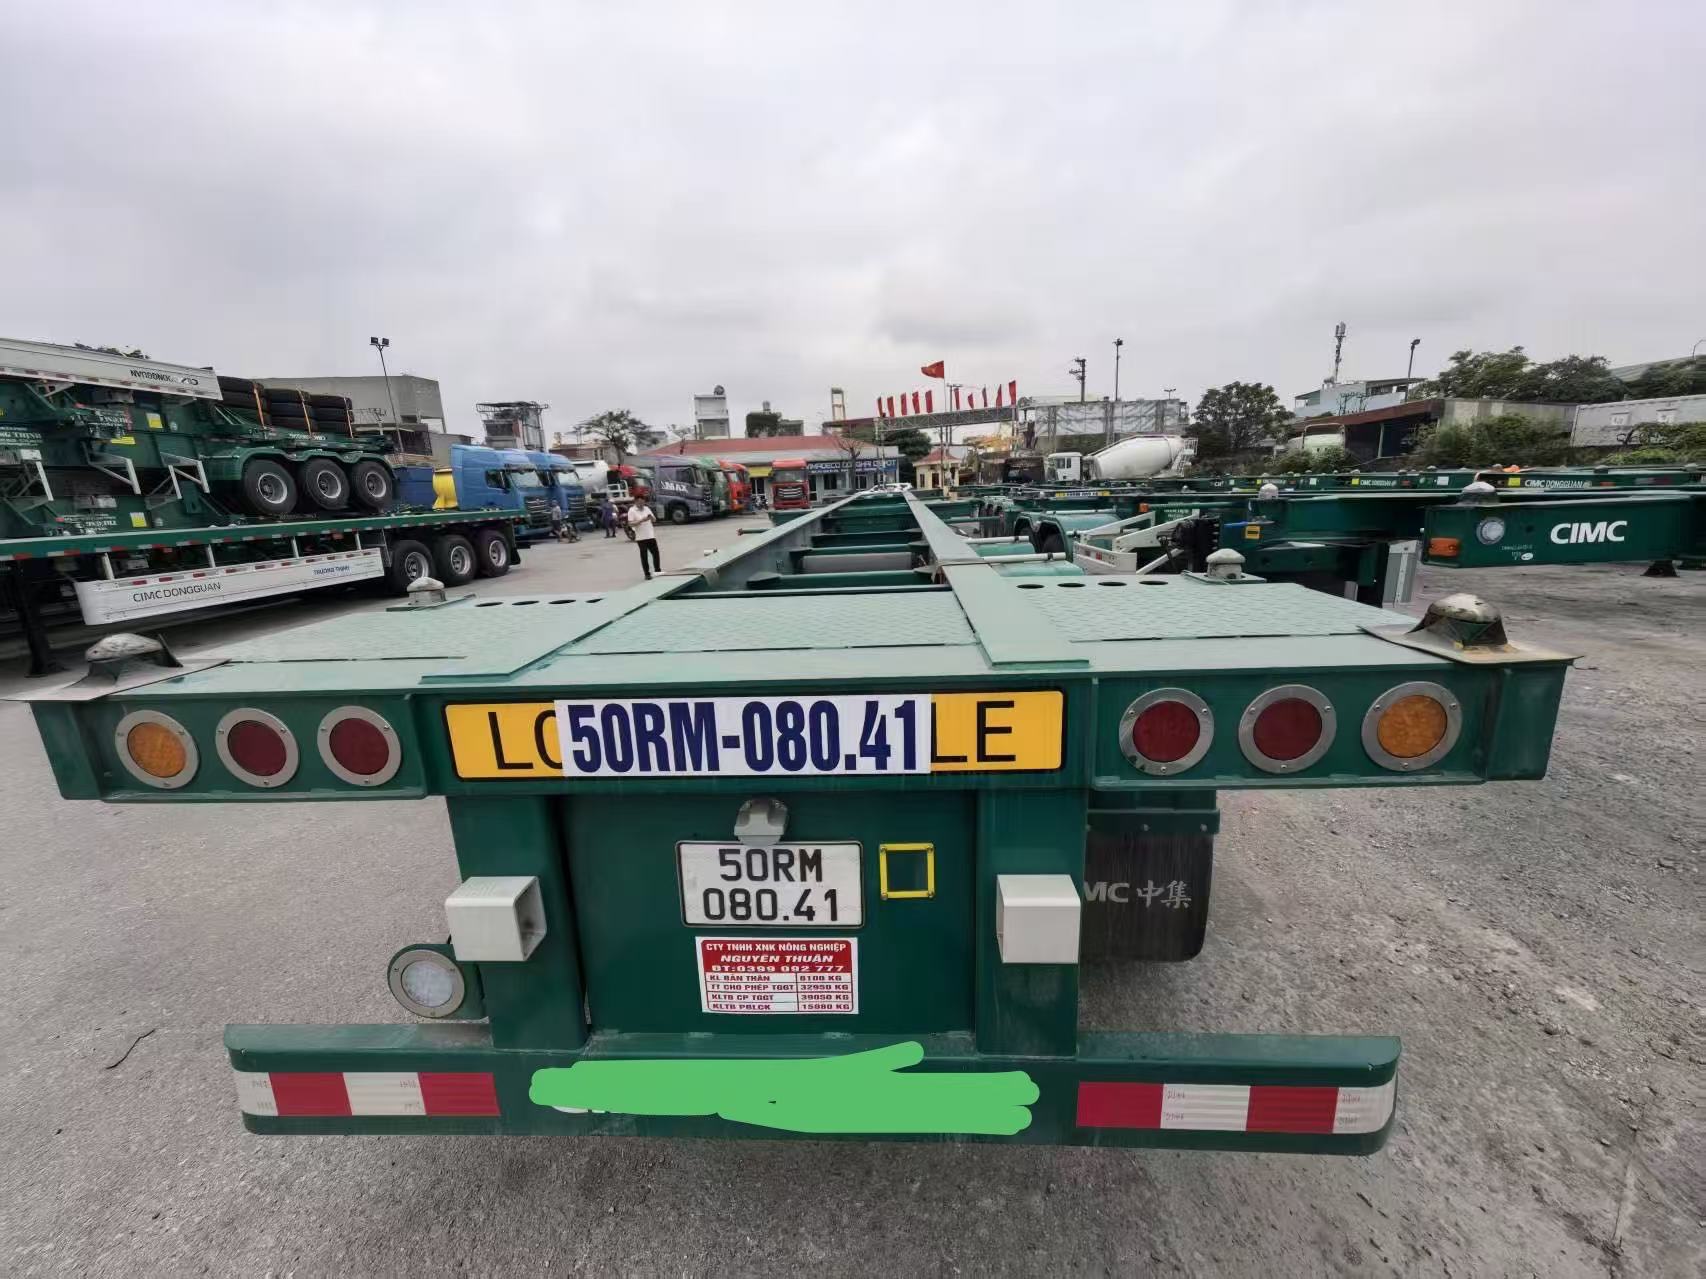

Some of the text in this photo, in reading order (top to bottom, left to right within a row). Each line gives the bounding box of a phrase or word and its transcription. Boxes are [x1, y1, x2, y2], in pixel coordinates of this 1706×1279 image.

[1550, 520, 1628, 545] CIMC
[133, 582, 222, 602] CIMC DONGGUAN
[570, 698, 919, 775] 50RM-080.41
[718, 848, 823, 882] 50RM
[702, 887, 838, 921] 080.41
[1136, 880, 1192, 909] 中集
[706, 942, 846, 953] CTY TNHH XNK NÔNG NGHIỆP
